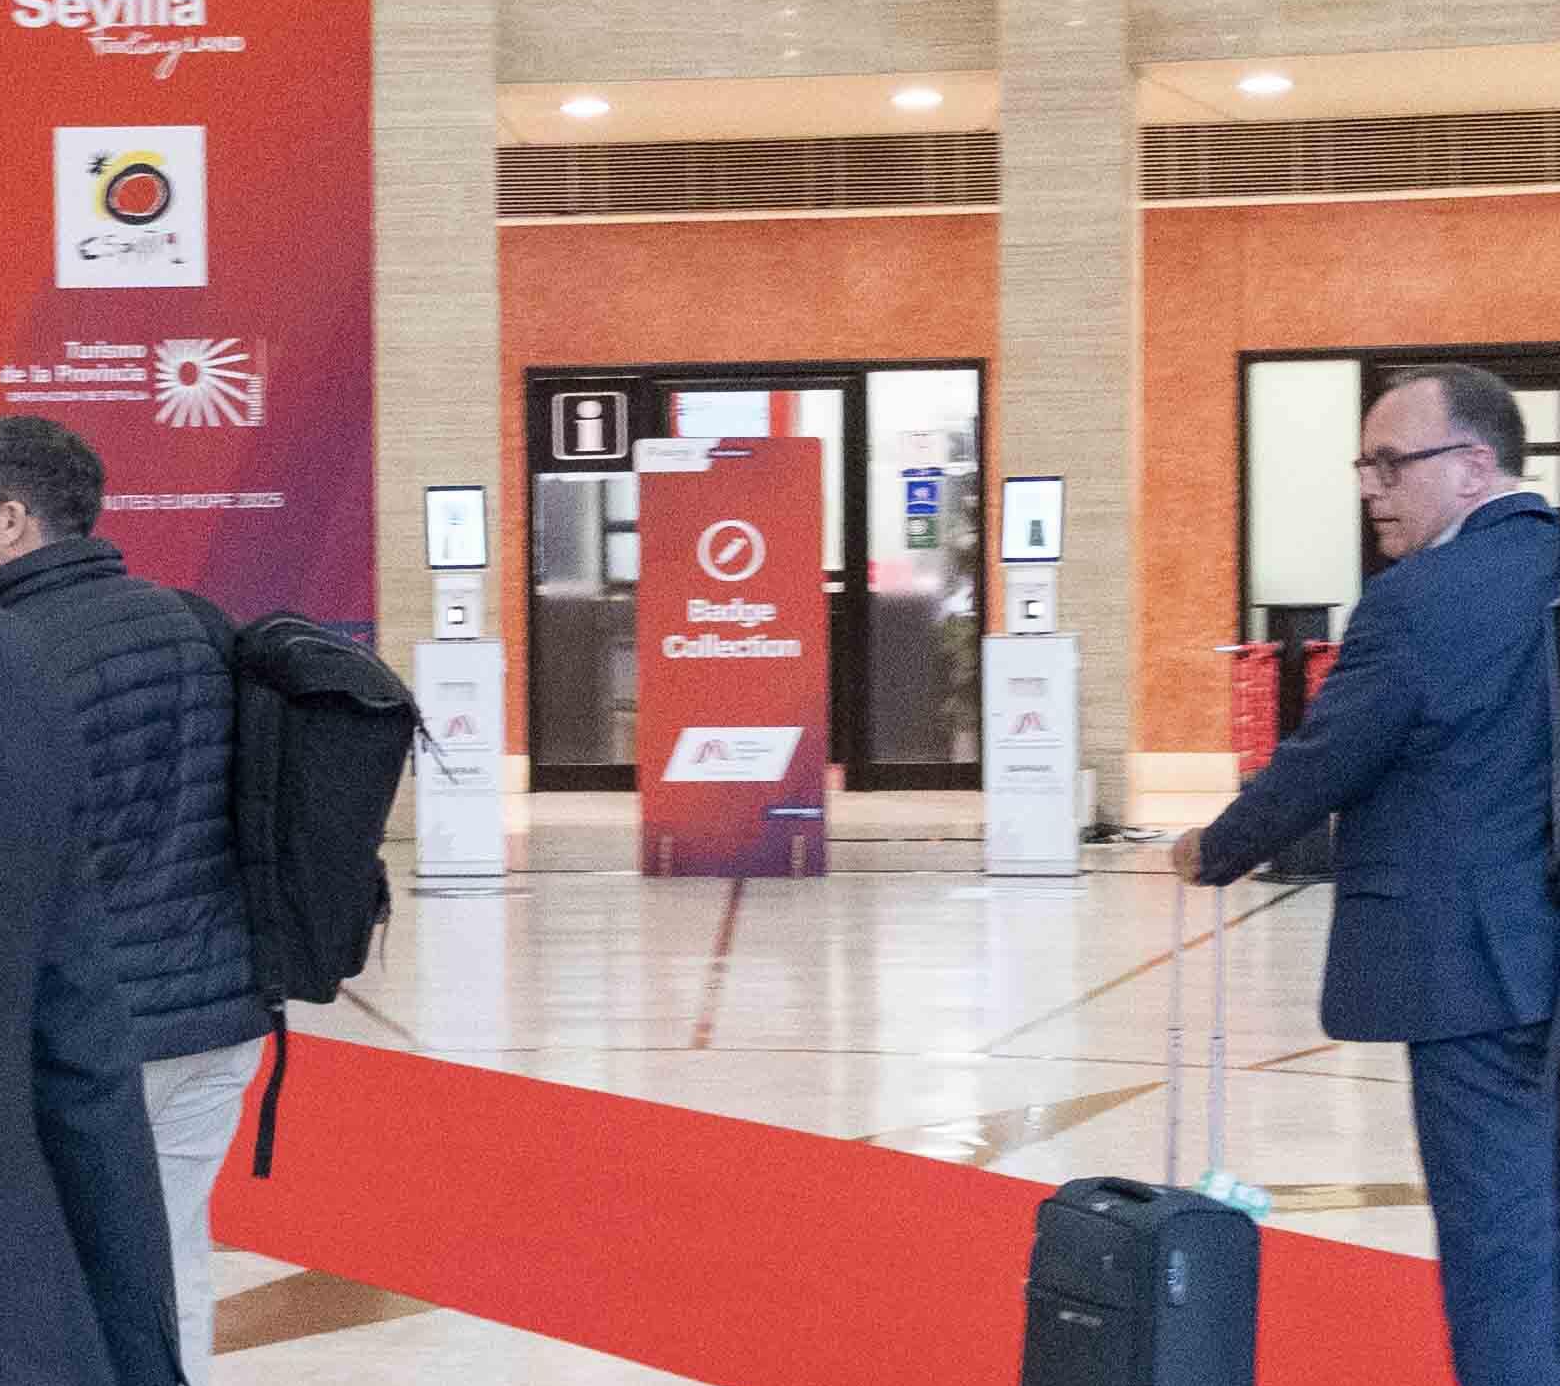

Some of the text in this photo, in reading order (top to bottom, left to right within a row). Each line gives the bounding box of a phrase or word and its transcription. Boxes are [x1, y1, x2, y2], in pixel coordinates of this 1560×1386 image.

[64, 341, 147, 359] Turismo
[29, 365, 52, 383] la
[53, 364, 147, 383] Provincia
[688, 597, 777, 628] Badge
[662, 633, 801, 659] Collection
